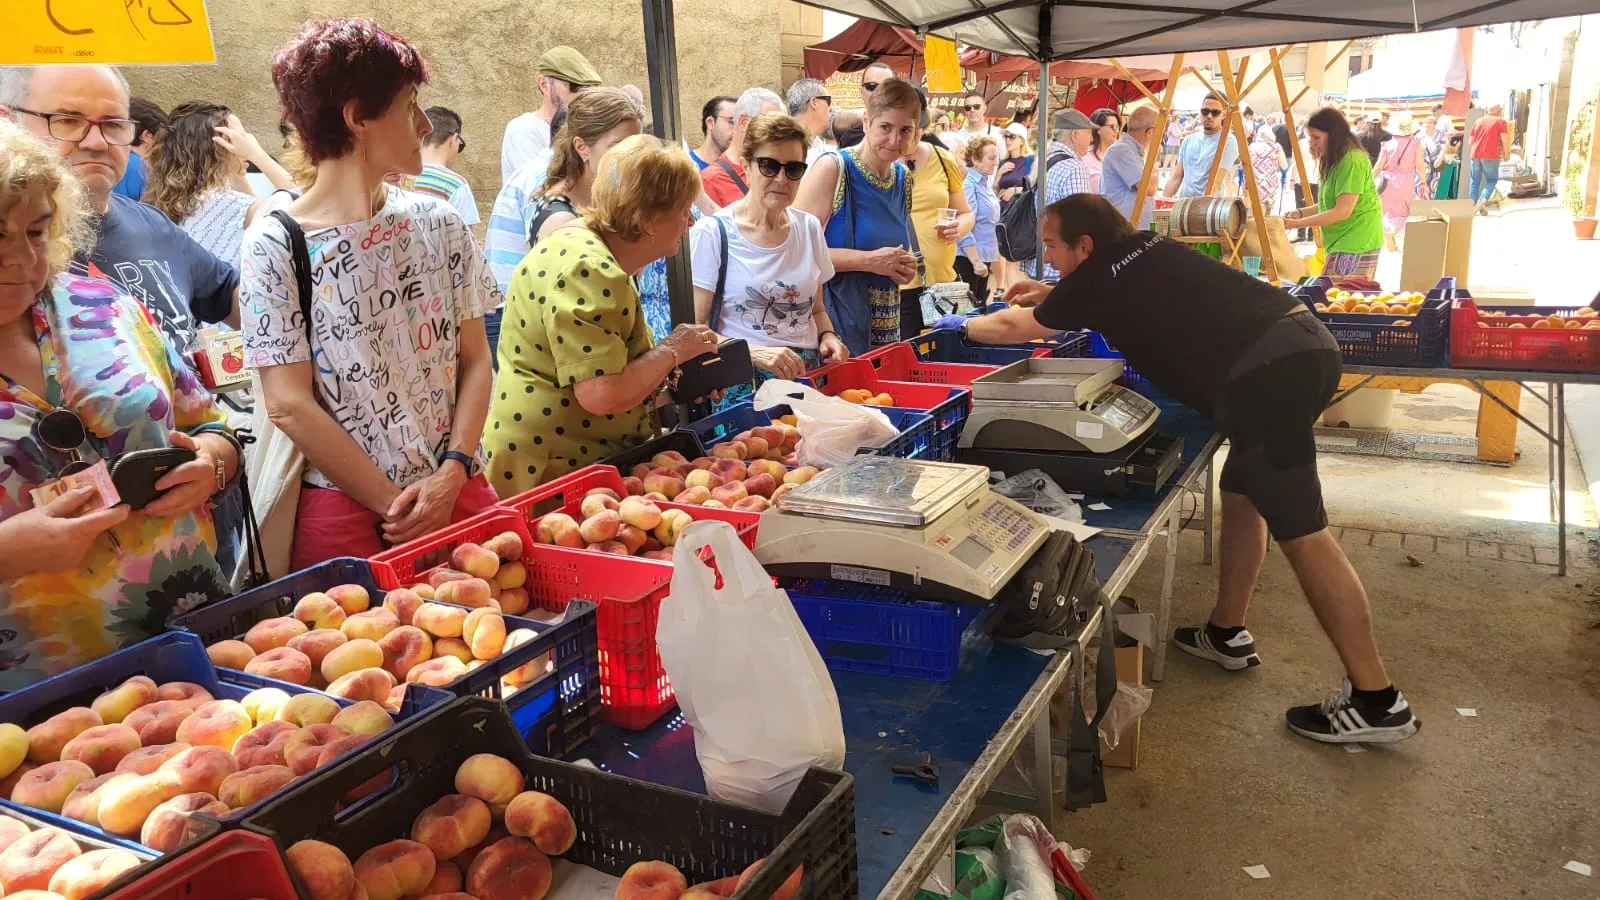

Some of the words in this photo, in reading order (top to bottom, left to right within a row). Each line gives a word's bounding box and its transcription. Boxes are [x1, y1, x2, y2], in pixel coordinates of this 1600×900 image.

[361, 218, 415, 250] Love
[1111, 248, 1144, 278] frutas
[369, 280, 425, 317] LOVE
